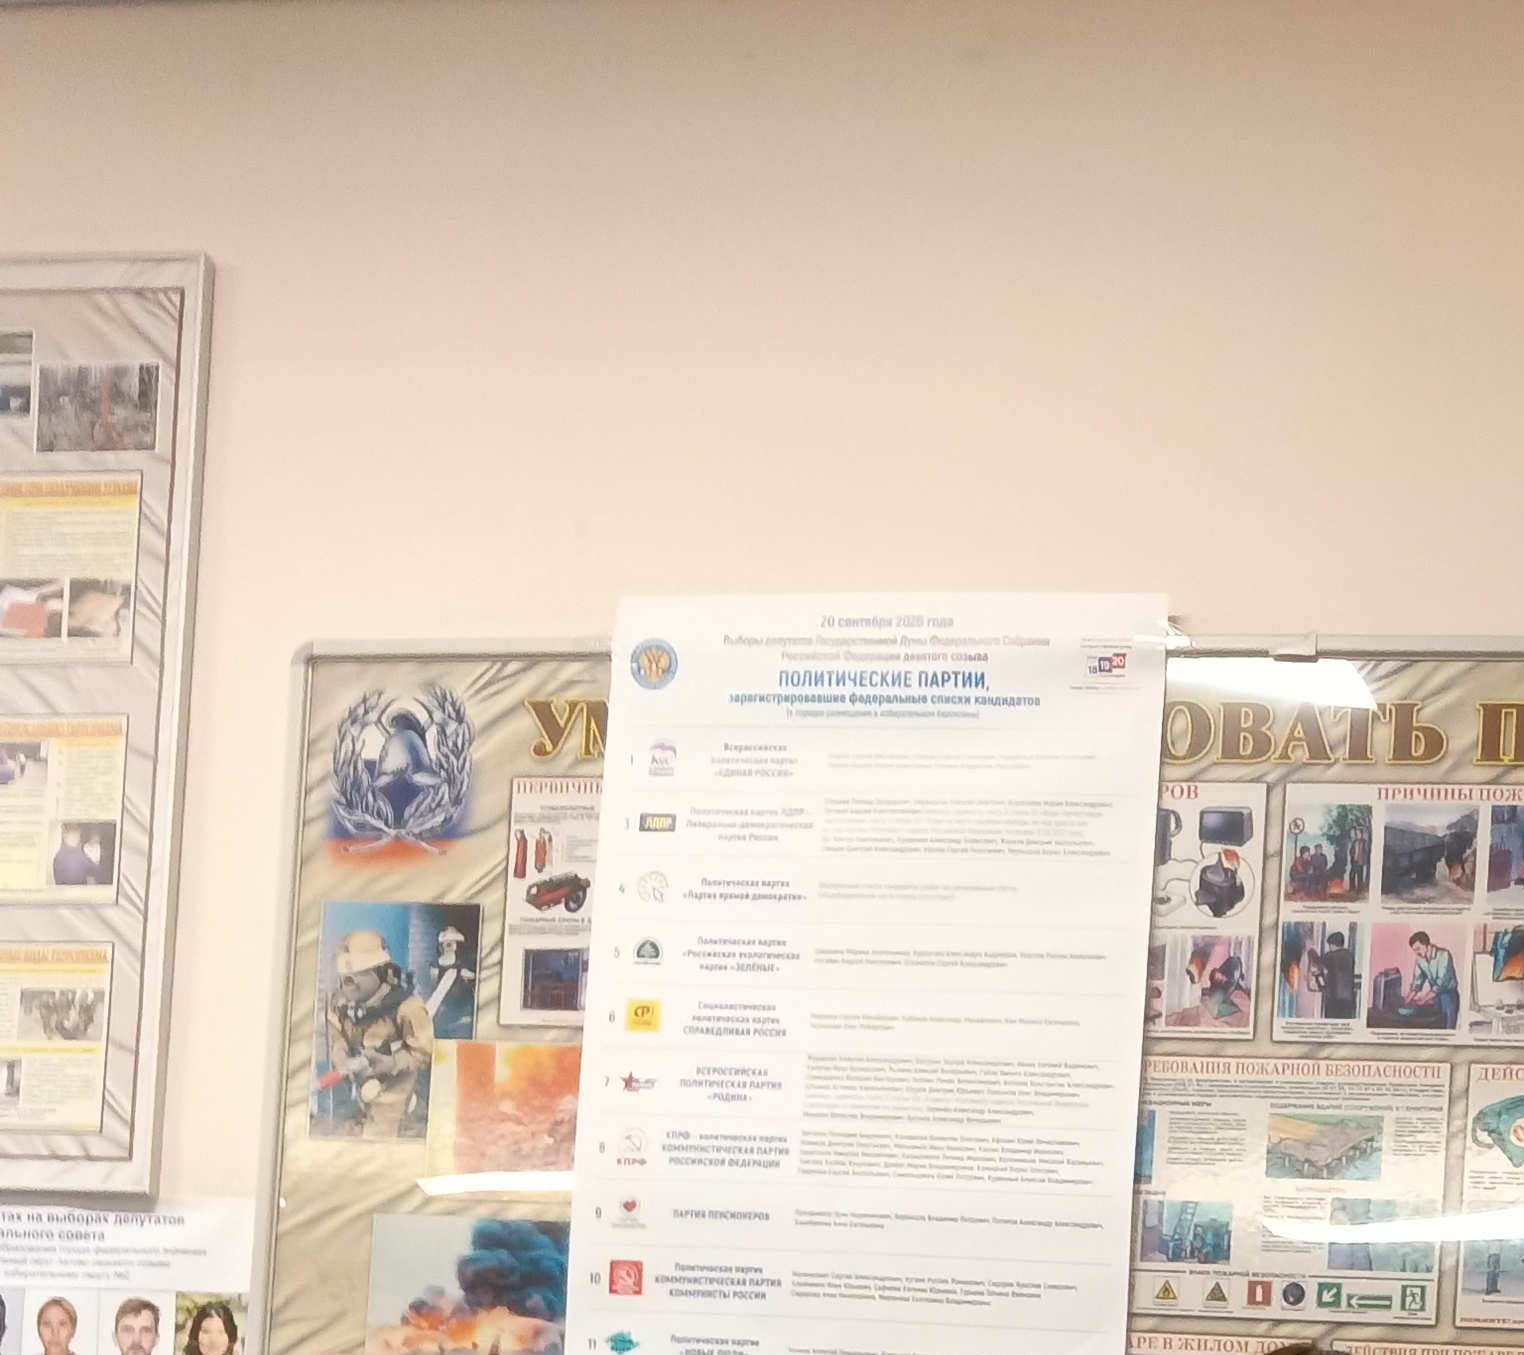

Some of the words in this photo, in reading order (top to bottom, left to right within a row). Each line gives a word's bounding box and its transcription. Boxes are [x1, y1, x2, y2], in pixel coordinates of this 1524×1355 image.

[820, 616, 836, 628] 20
[837, 617, 893, 631] сентября
[926, 618, 954, 630] года
[778, 669, 913, 688] ПОЛИТИЧЕСКИЕ
[918, 670, 990, 692] ПАРТИИ,
[728, 692, 846, 706] зарегистрировавшие
[848, 692, 928, 707] федеральные
[930, 694, 971, 707] списки
[974, 695, 1041, 708] кандидатов
[1377, 787, 1475, 802] ПРИЧИНЫ
[683, 1026, 751, 1037] СПРАВЕДЛИВАЯ
[753, 1027, 787, 1038] РОССИЯ
[696, 1066, 768, 1077] ВСЕРОССИЙСКАЯ
[1235, 1061, 1321, 1077] ПОЖАРНОЙ
[1325, 1064, 1442, 1080] БЕЗОПАСНОСТИ
[680, 1079, 747, 1090] ПОЛИТИЧЕСКАЯ
[749, 1081, 783, 1090] ПАРТИЯ
[662, 1144, 755, 1156] КОММУНИСТИЧЕСКАЯ
[756, 1146, 790, 1156] ПАРТИЯ
[616, 1158, 648, 1166] КПРФ
[669, 1157, 726, 1168] РОССИЙСКОЙ
[728, 1158, 781, 1169] ФЕДЕРАЦИИ
[27, 1213, 43, 1223] на
[47, 1212, 109, 1226] выборах
[113, 1213, 185, 1228] депутатов
[673, 1210, 706, 1220] ПАРТИЯ
[708, 1210, 770, 1222] ПЕНСИОНЕРОВ
[58, 1230, 105, 1241] совета
[590, 1272, 601, 1285] 10
[655, 1276, 747, 1288] КОММУНИСТИЧЕСКАЯ
[749, 1278, 782, 1288] ПАРТИЯ
[669, 1289, 731, 1300] КОММУНИСТЫ
[1163, 1338, 1174, 1351] В
[1178, 1338, 1250, 1353] ЖИЛОМ
